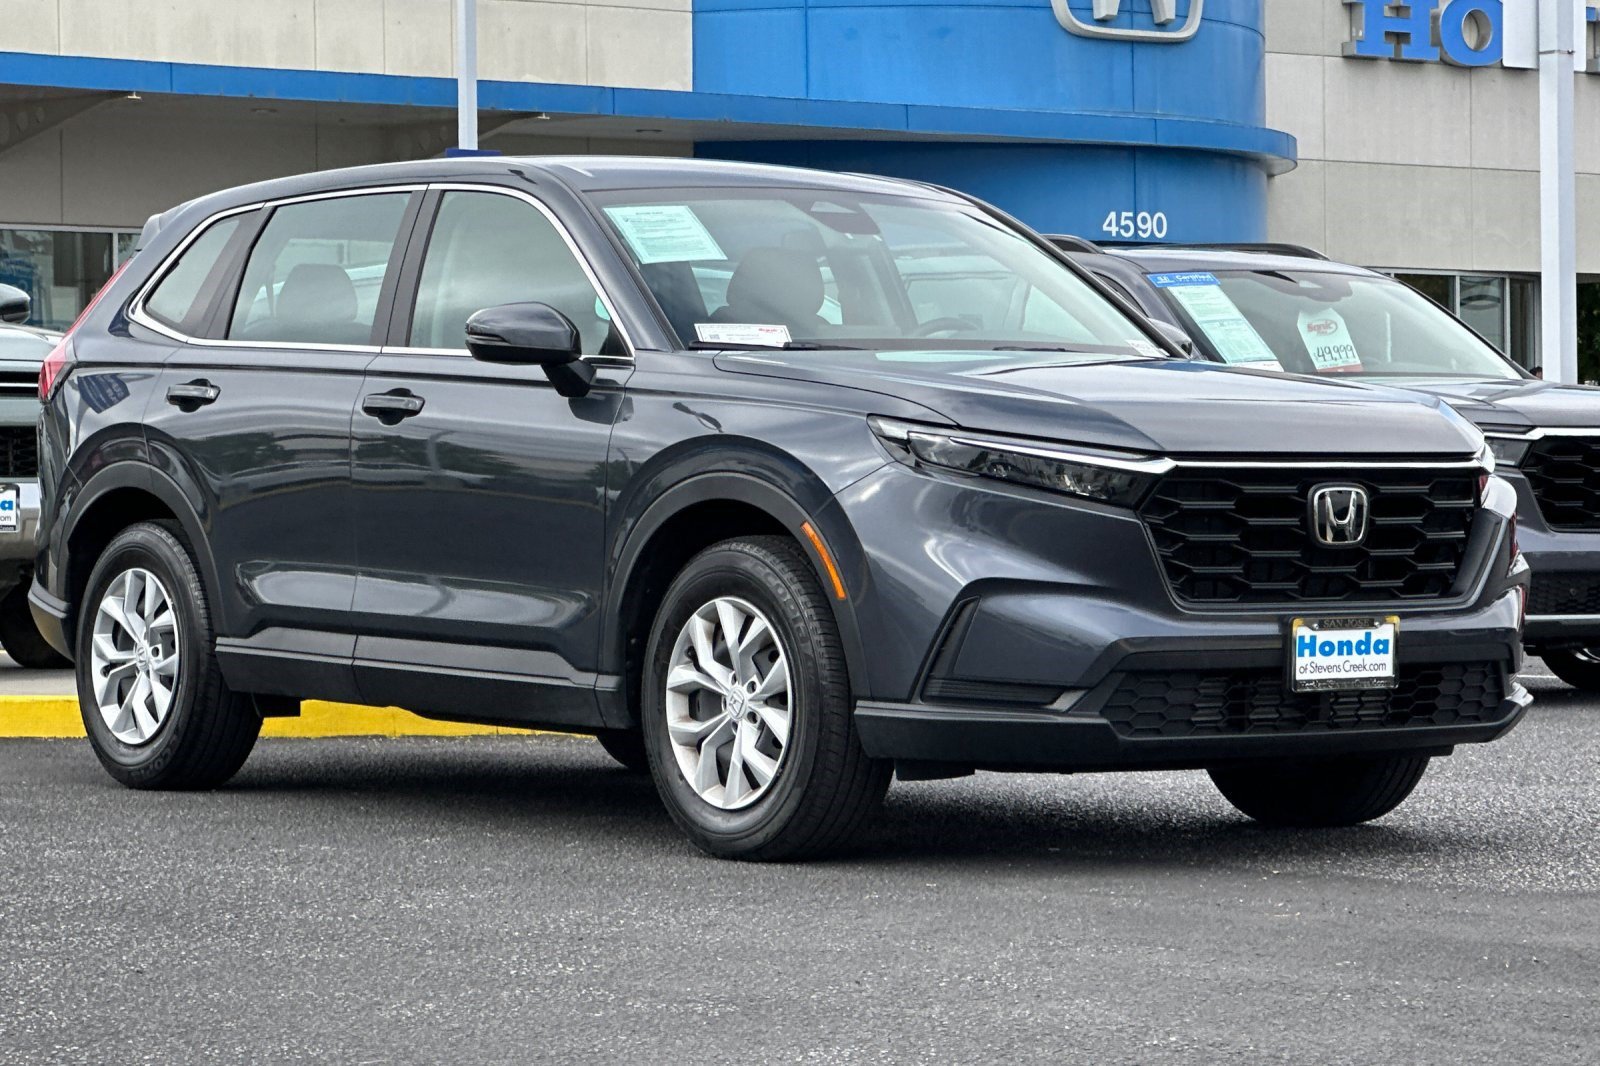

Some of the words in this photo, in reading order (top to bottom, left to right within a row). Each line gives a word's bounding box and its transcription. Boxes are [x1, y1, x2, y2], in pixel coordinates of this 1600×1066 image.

[1103, 211, 1168, 238] 4590
[1323, 619, 1342, 628] SAN
[1298, 631, 1389, 658] Honda
[1299, 664, 1308, 674] of
[1309, 661, 1341, 674] Stevens
[1343, 658, 1387, 672] Creek.com
